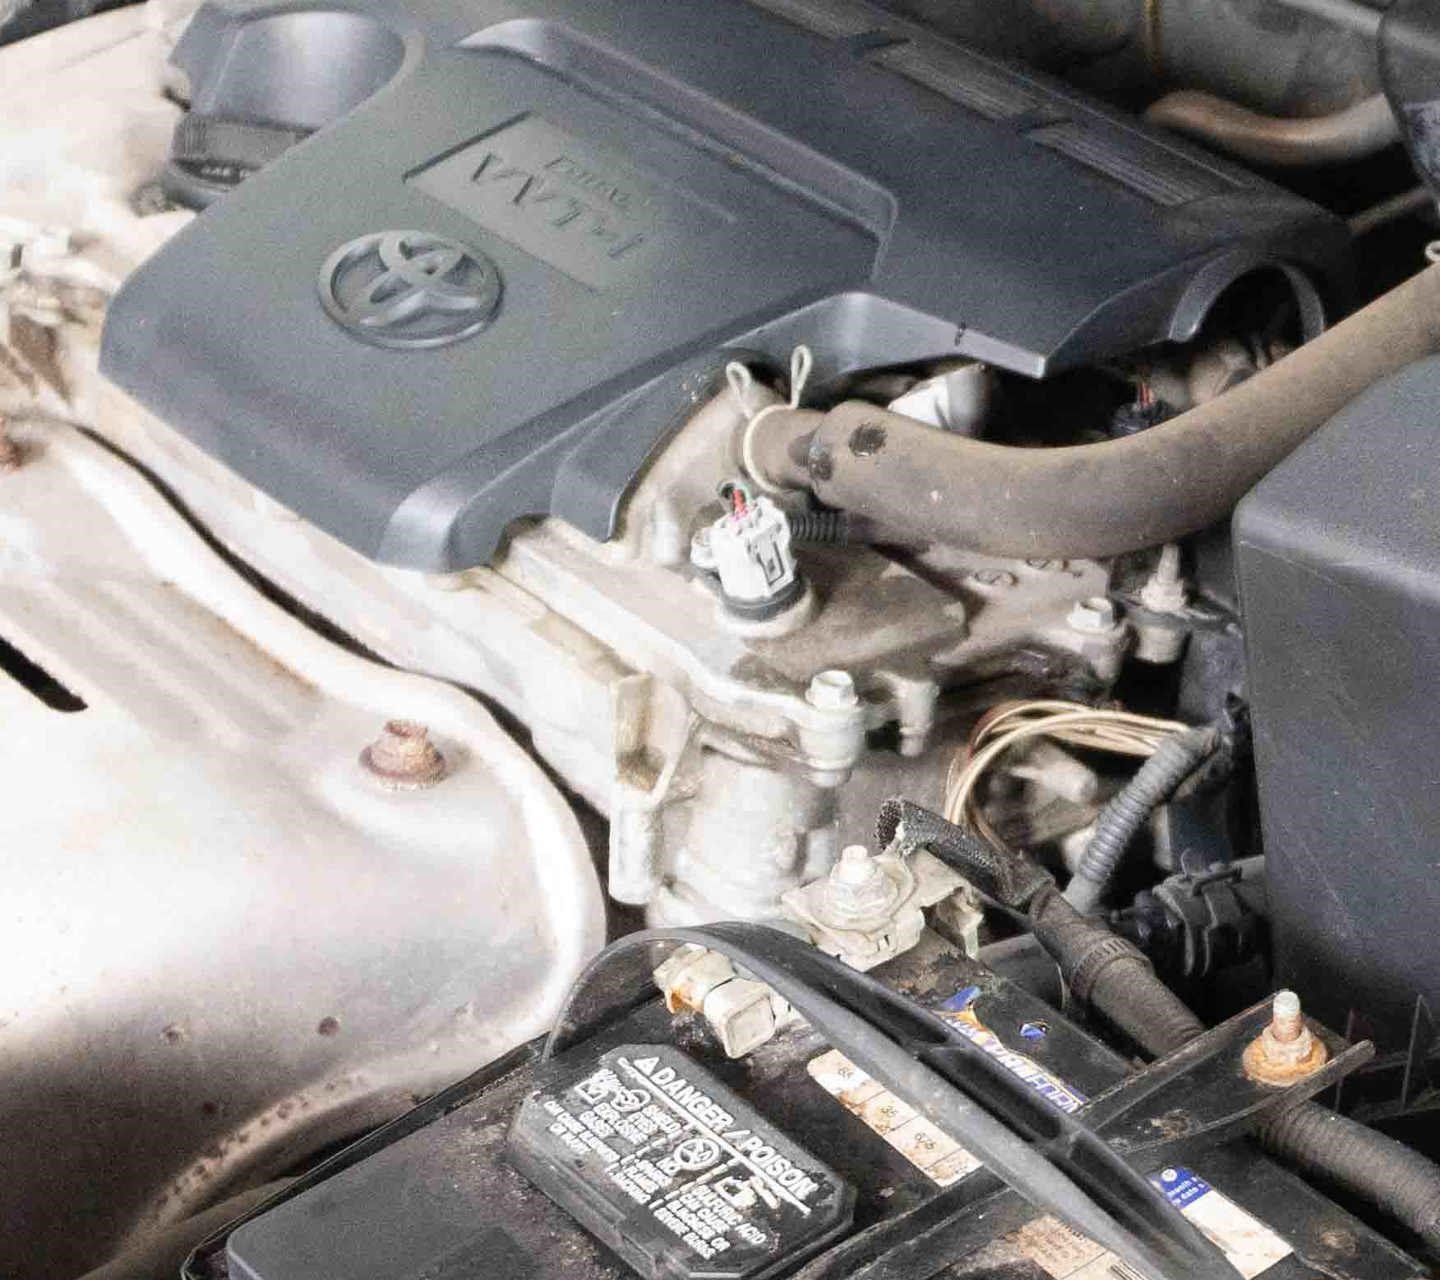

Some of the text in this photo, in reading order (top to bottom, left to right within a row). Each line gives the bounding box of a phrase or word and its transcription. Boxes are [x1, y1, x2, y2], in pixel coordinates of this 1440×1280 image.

[653, 1067, 736, 1132] DANGER
[741, 1134, 819, 1199] POISON
[656, 1157, 684, 1176] NO
[734, 1223, 766, 1245] ACID
